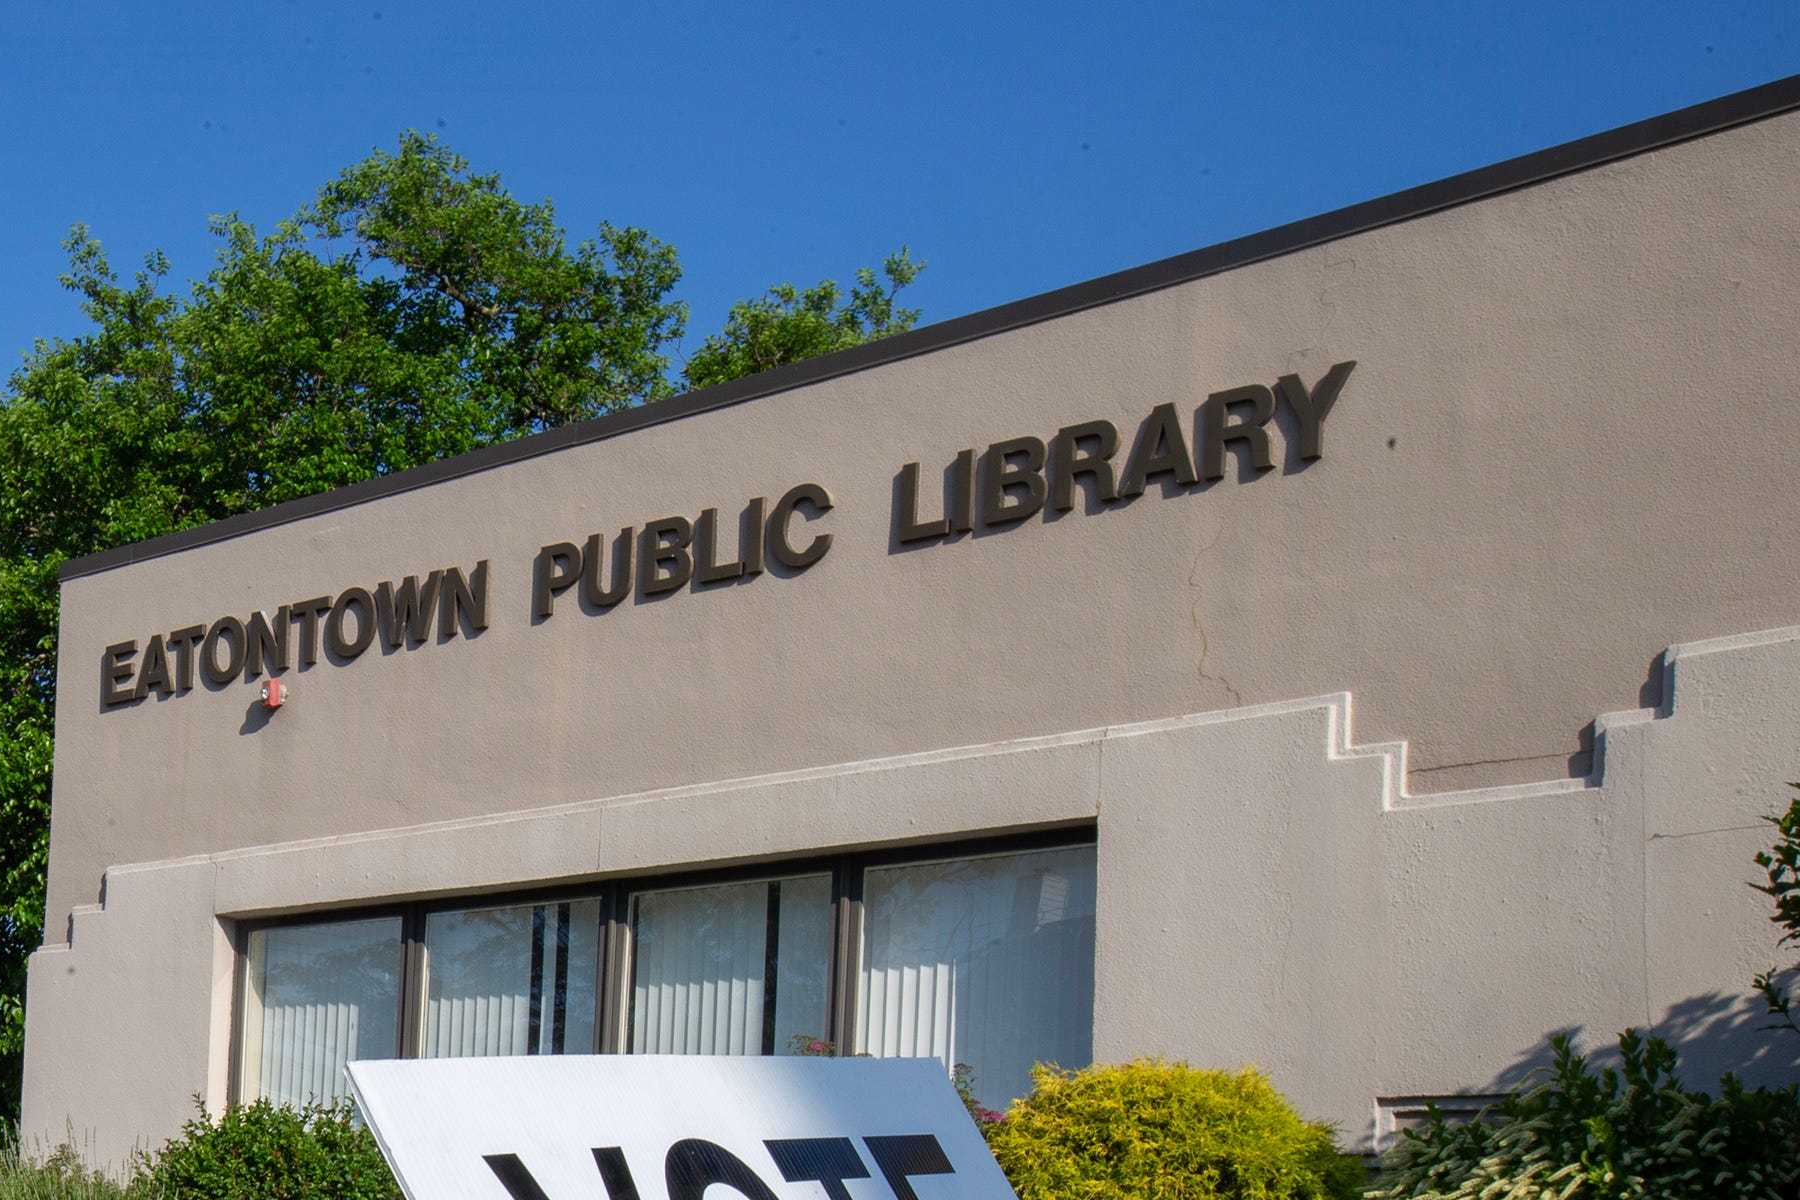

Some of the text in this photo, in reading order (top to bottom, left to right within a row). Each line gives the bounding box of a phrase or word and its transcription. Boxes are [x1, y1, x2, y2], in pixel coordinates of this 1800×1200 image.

[100, 360, 1358, 709] EATONTOWN PUBLIC LIBRARY
